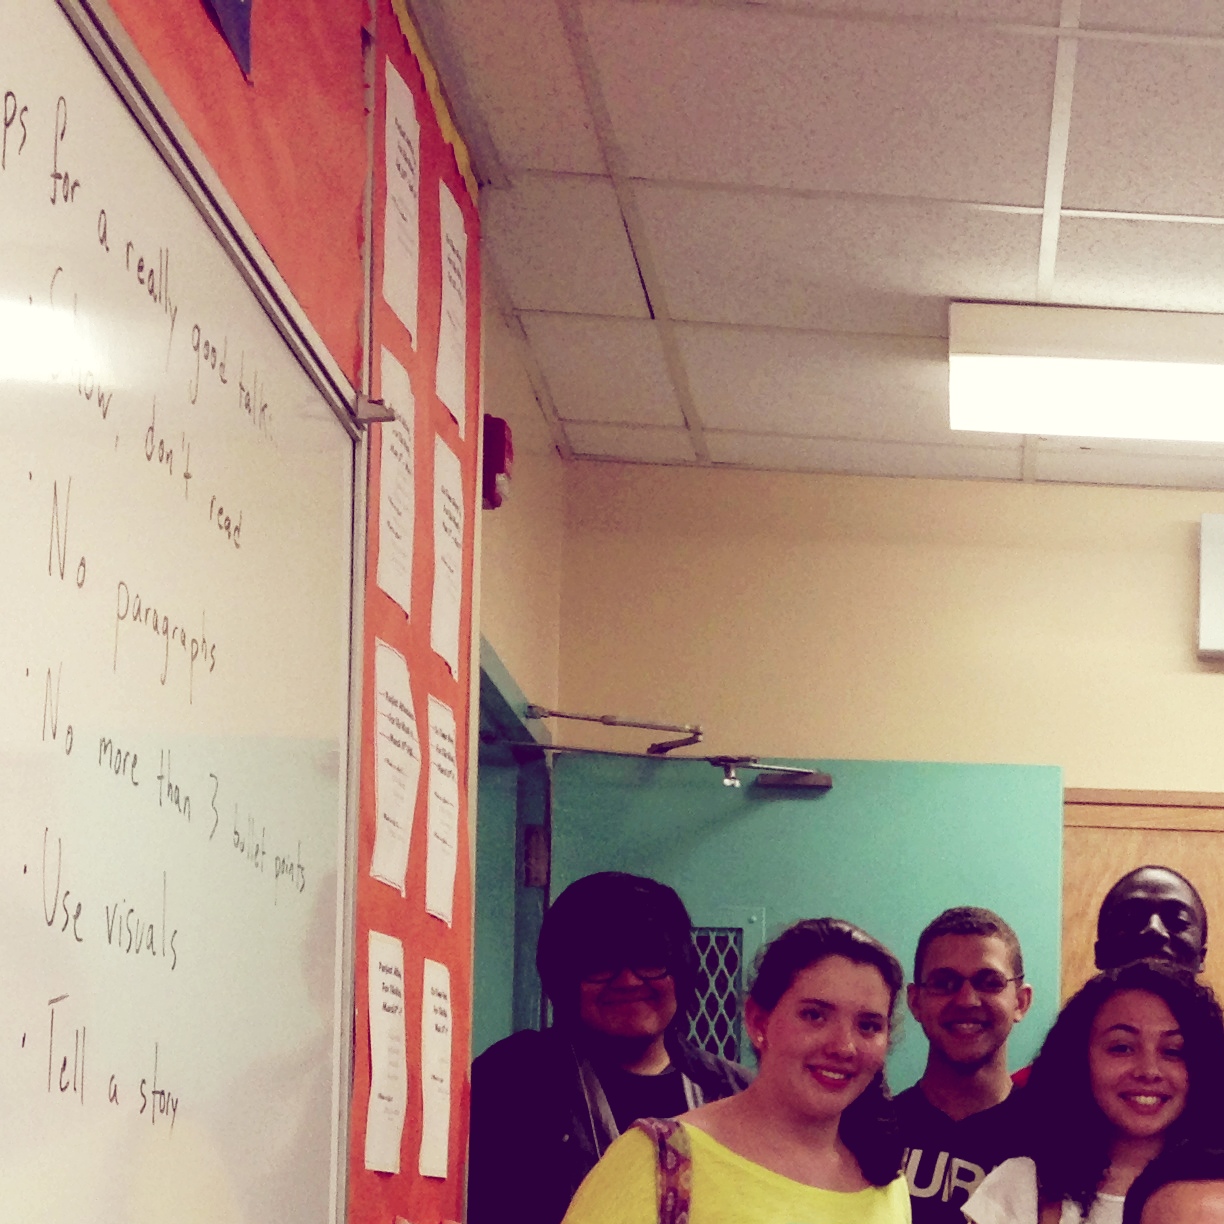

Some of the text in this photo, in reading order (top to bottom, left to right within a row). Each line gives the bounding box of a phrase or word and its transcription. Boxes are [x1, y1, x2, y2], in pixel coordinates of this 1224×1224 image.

[50, 95, 80, 205] for
[98, 208, 109, 252] a
[126, 240, 178, 373] really
[189, 323, 228, 405] good
[48, 476, 87, 589] No
[145, 394, 192, 500] don't
[210, 494, 243, 549] read
[42, 661, 306, 906] No more than 3 bullet points
[43, 827, 178, 971] Use visuals
[48, 993, 179, 1131] Tell a story
